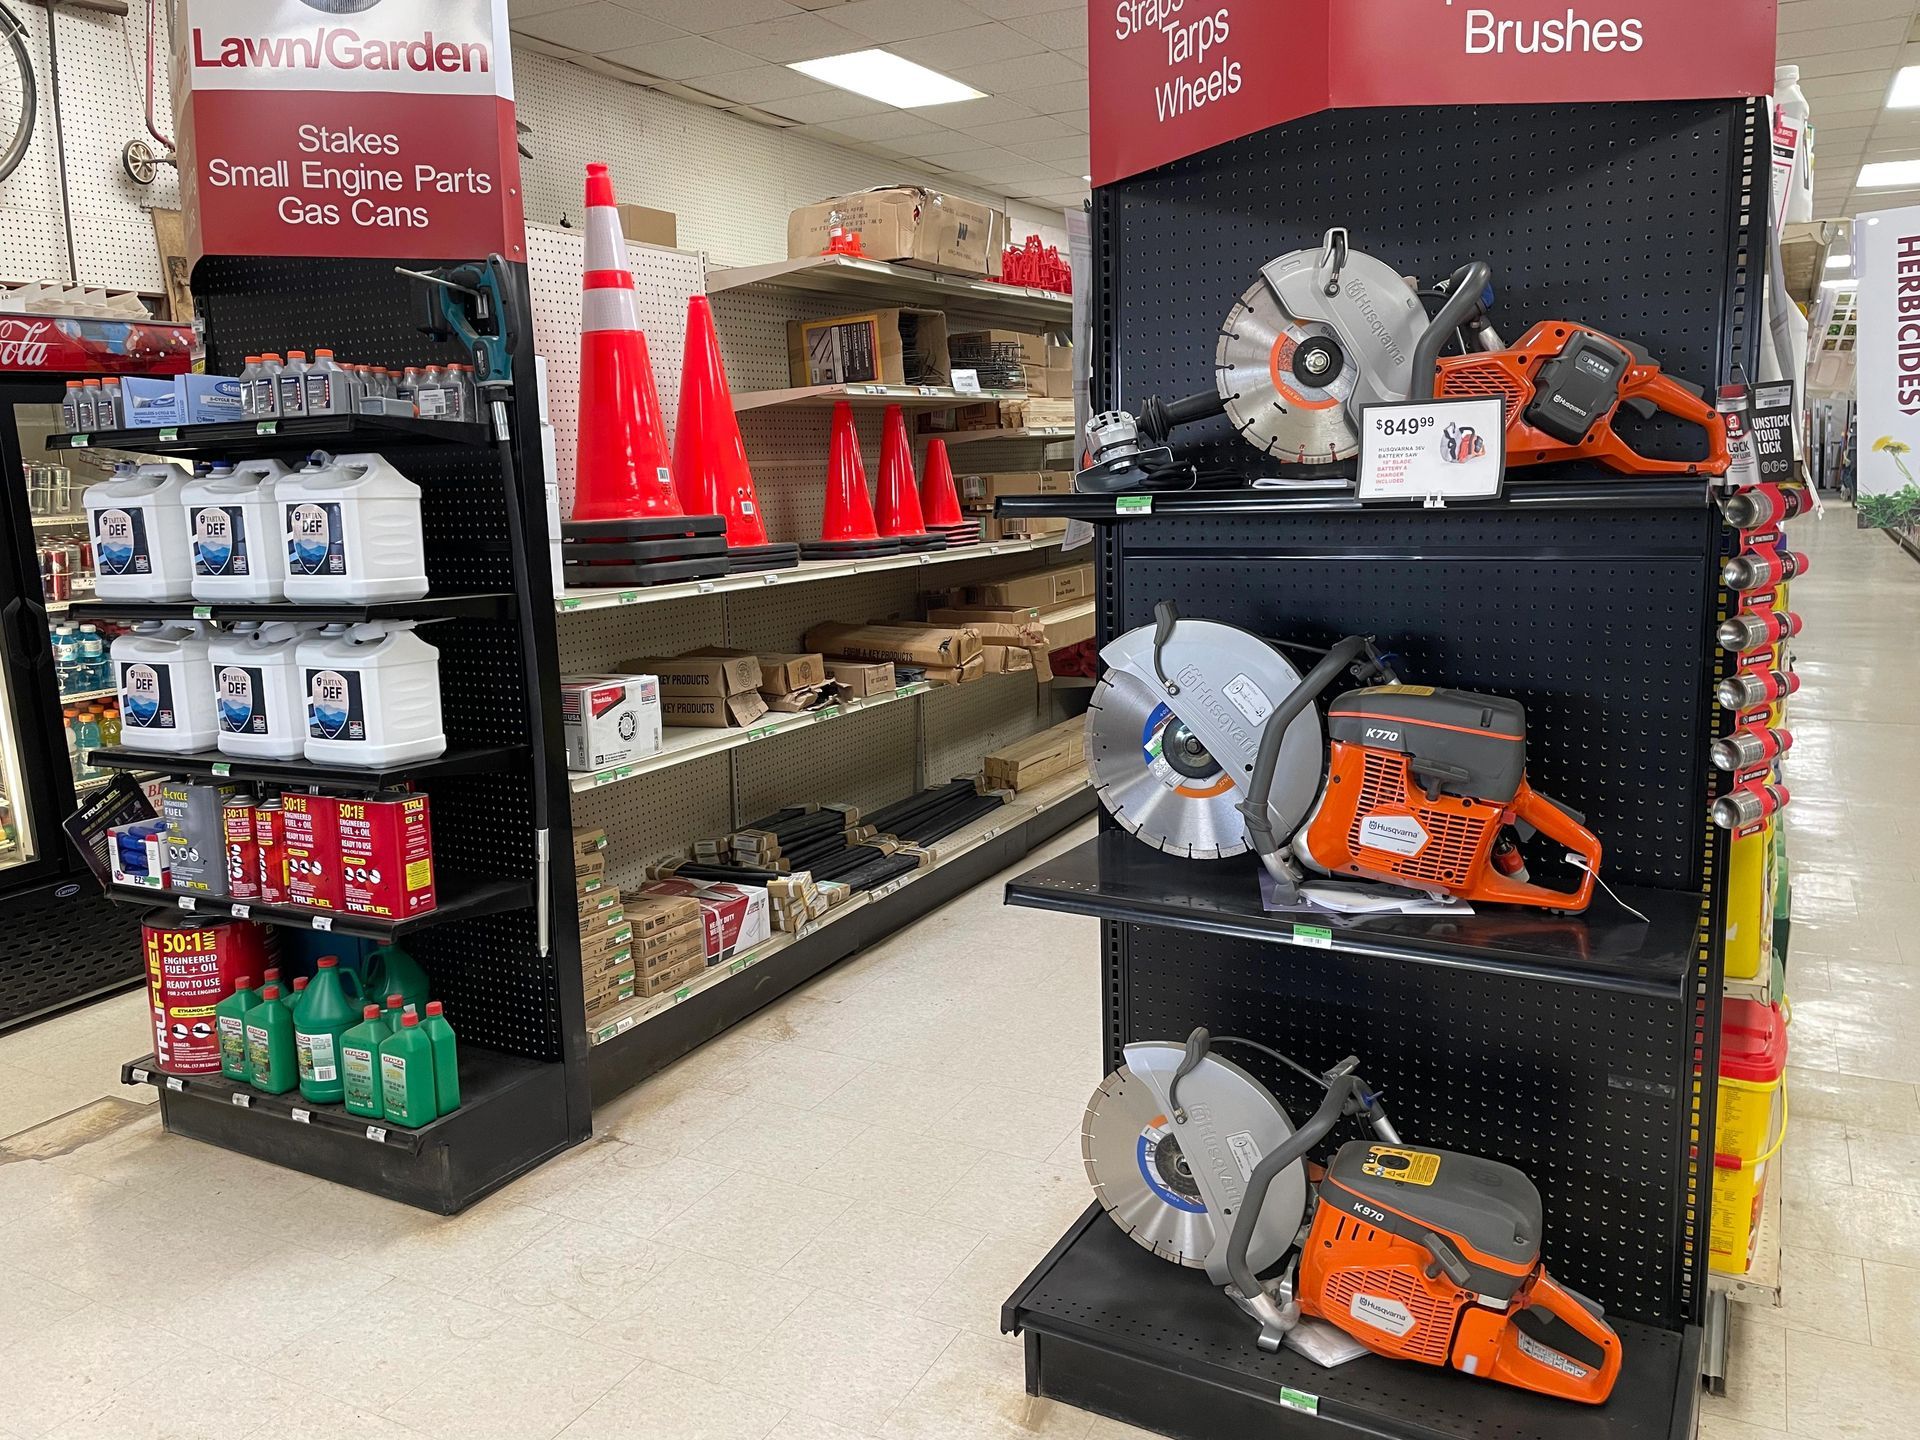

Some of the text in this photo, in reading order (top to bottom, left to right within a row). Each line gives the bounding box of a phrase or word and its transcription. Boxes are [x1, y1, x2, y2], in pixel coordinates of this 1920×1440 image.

[1116, 0, 1183, 40] Straps
[1162, 8, 1230, 66] Tarps
[1465, 8, 1643, 54] Brushes
[192, 28, 490, 73] Lawn/Garden
[1155, 56, 1242, 122] Wheels
[298, 124, 400, 155] Stakes
[208, 158, 492, 197] Small Engine Parts
[278, 196, 429, 228] Gas Cans
[1898, 235, 1920, 405] HERBICIDES
[1357, 293, 1406, 367] Husqvarna
[222, 383, 240, 393] Sten
[1560, 397, 1587, 417] Husqvarna
[1752, 414, 1790, 430] UNSTICK
[1754, 428, 1781, 442] YOUR
[1758, 441, 1782, 455] LOCK
[108, 524, 127, 536] DEF
[206, 522, 226, 536] DEF
[302, 520, 323, 533] DEF
[882, 651, 913, 661] PRODUCTS
[135, 671, 153, 679] TARTAN
[227, 674, 247, 682] TARTAN
[672, 674, 709, 685] PRODUCTS
[136, 678, 153, 691] DEF
[228, 682, 247, 695] DEF
[322, 679, 342, 687] TARTAN
[322, 686, 342, 699] DEF
[677, 703, 715, 714] PRODUCTS
[1193, 683, 1257, 760] Husqvarn
[1366, 728, 1398, 742] K770
[163, 787, 188, 801] 4-CYCLE
[81, 789, 120, 820] TRUFUEL
[283, 797, 300, 811] 50:1
[403, 799, 423, 811] TRU
[165, 807, 183, 817] FUEL
[227, 808, 243, 818] 50:1
[284, 811, 312, 821] ENGINEERED
[339, 804, 358, 818] 50:1
[285, 819, 297, 828] FUEL
[303, 821, 313, 829] OIL
[340, 819, 371, 828] ENGINEERED
[286, 832, 299, 840] READY
[341, 826, 354, 836] FUEL
[361, 828, 371, 837] OIL
[1377, 823, 1418, 840] Husqvarna
[342, 839, 355, 848] READY
[362, 841, 372, 850] USE
[172, 879, 210, 891] TRUFUEL
[292, 895, 333, 908] TRUFUEL
[346, 902, 392, 915] TRUFUEL
[723, 913, 735, 924] DUTY
[163, 931, 216, 953] 50:1 MIX
[164, 954, 218, 965] ENGINEERED
[165, 964, 187, 974] FUEL
[201, 962, 219, 972] OIL
[166, 977, 221, 989] READY TO USE
[148, 933, 170, 1064] TRUFUEL
[346, 1049, 368, 1059] ITASCA
[384, 1056, 404, 1066] ITASCA
[1367, 1302, 1406, 1321] Husqvarna
